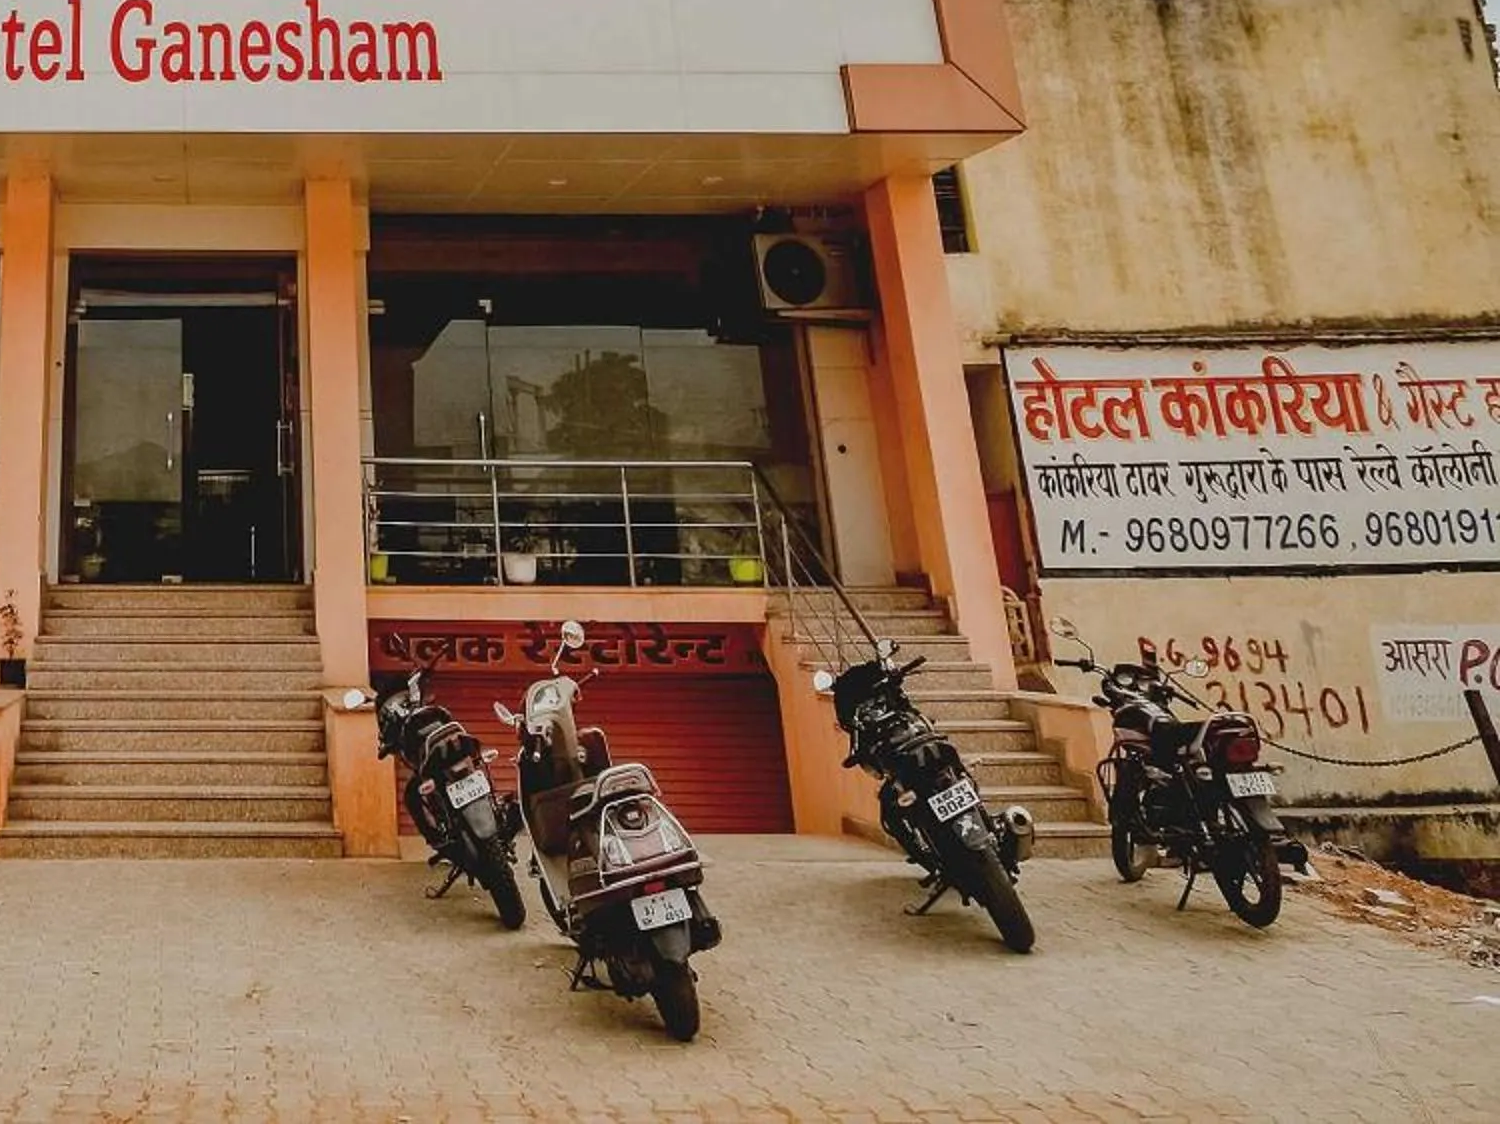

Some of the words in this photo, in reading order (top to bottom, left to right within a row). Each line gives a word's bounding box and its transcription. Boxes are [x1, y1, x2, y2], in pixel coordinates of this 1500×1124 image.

[1014, 357, 1150, 440] होटल
[1151, 355, 1370, 438] कांकरिया
[1033, 453, 1121, 499] कांकरिया
[1121, 462, 1176, 497] टावर
[1258, 447, 1289, 493] के
[1291, 457, 1348, 492] पास
[1124, 513, 1341, 553] 9680977266
[1381, 639, 1453, 681] आसरा
